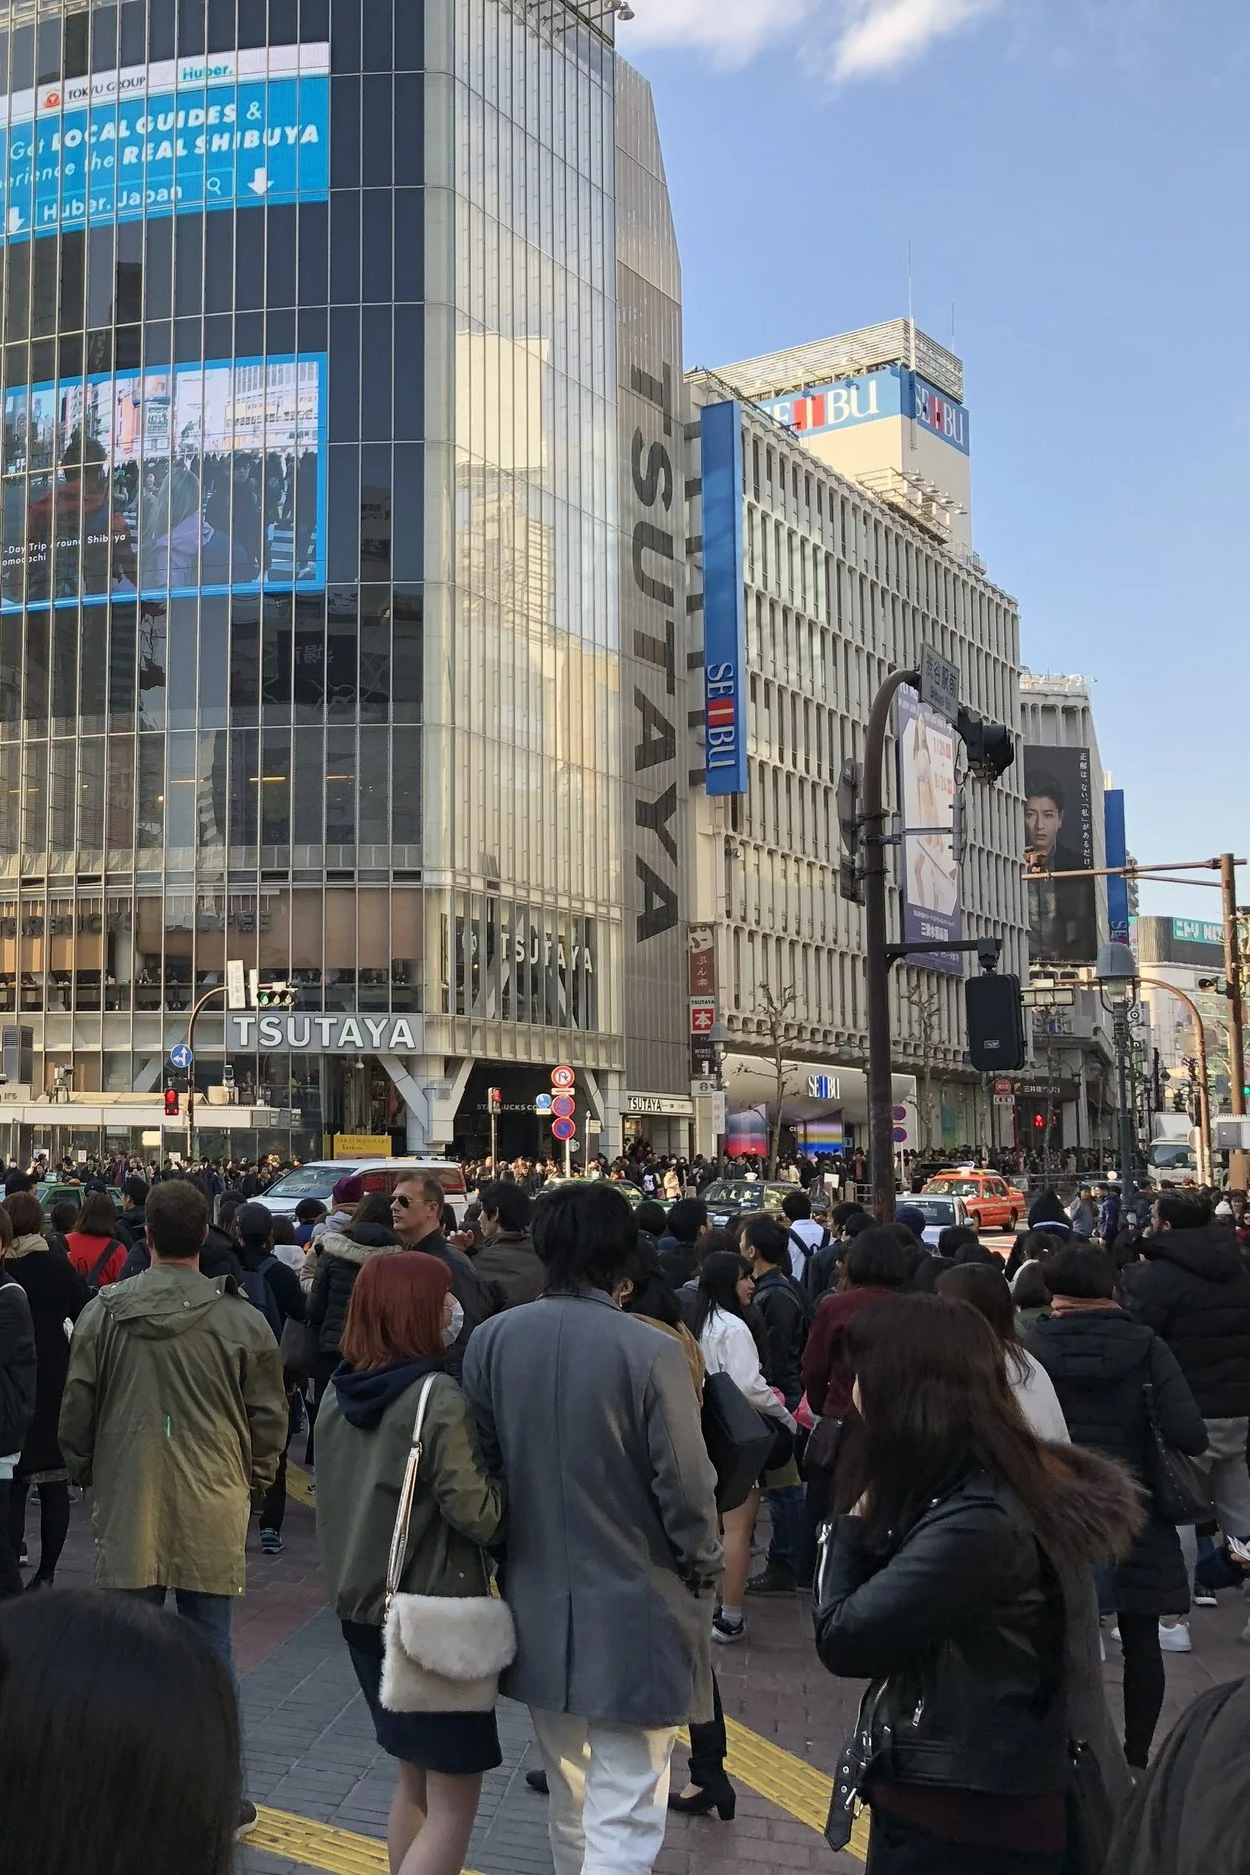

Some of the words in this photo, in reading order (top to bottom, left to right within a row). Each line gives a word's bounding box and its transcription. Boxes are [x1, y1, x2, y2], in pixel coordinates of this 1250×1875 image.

[182, 64, 233, 81] Huber.
[10, 138, 45, 160] Get
[52, 119, 131, 152] LOCAL
[136, 103, 237, 136] GUIDES
[246, 101, 262, 120] &
[84, 152, 115, 173] the
[122, 137, 188, 166] REAL
[193, 124, 319, 154] SHIBUYA
[42, 193, 111, 222] Huber.
[117, 182, 183, 212] Japan
[760, 379, 880, 430] EIBU
[914, 383, 964, 447] SEIBU
[29, 542, 47, 552] Trip
[87, 533, 126, 545] Shibya
[0, 553, 47, 567] omoachi
[631, 362, 679, 942] TSUTAYA
[707, 661, 736, 769] SEIBU
[1175, 920, 1199, 938] ニトリ
[232, 1016, 416, 1049] TSUTAYA
[695, 1010, 712, 1028] 本
[808, 1074, 840, 1099] SEIBU
[628, 1097, 662, 1111] TSUTAYA
